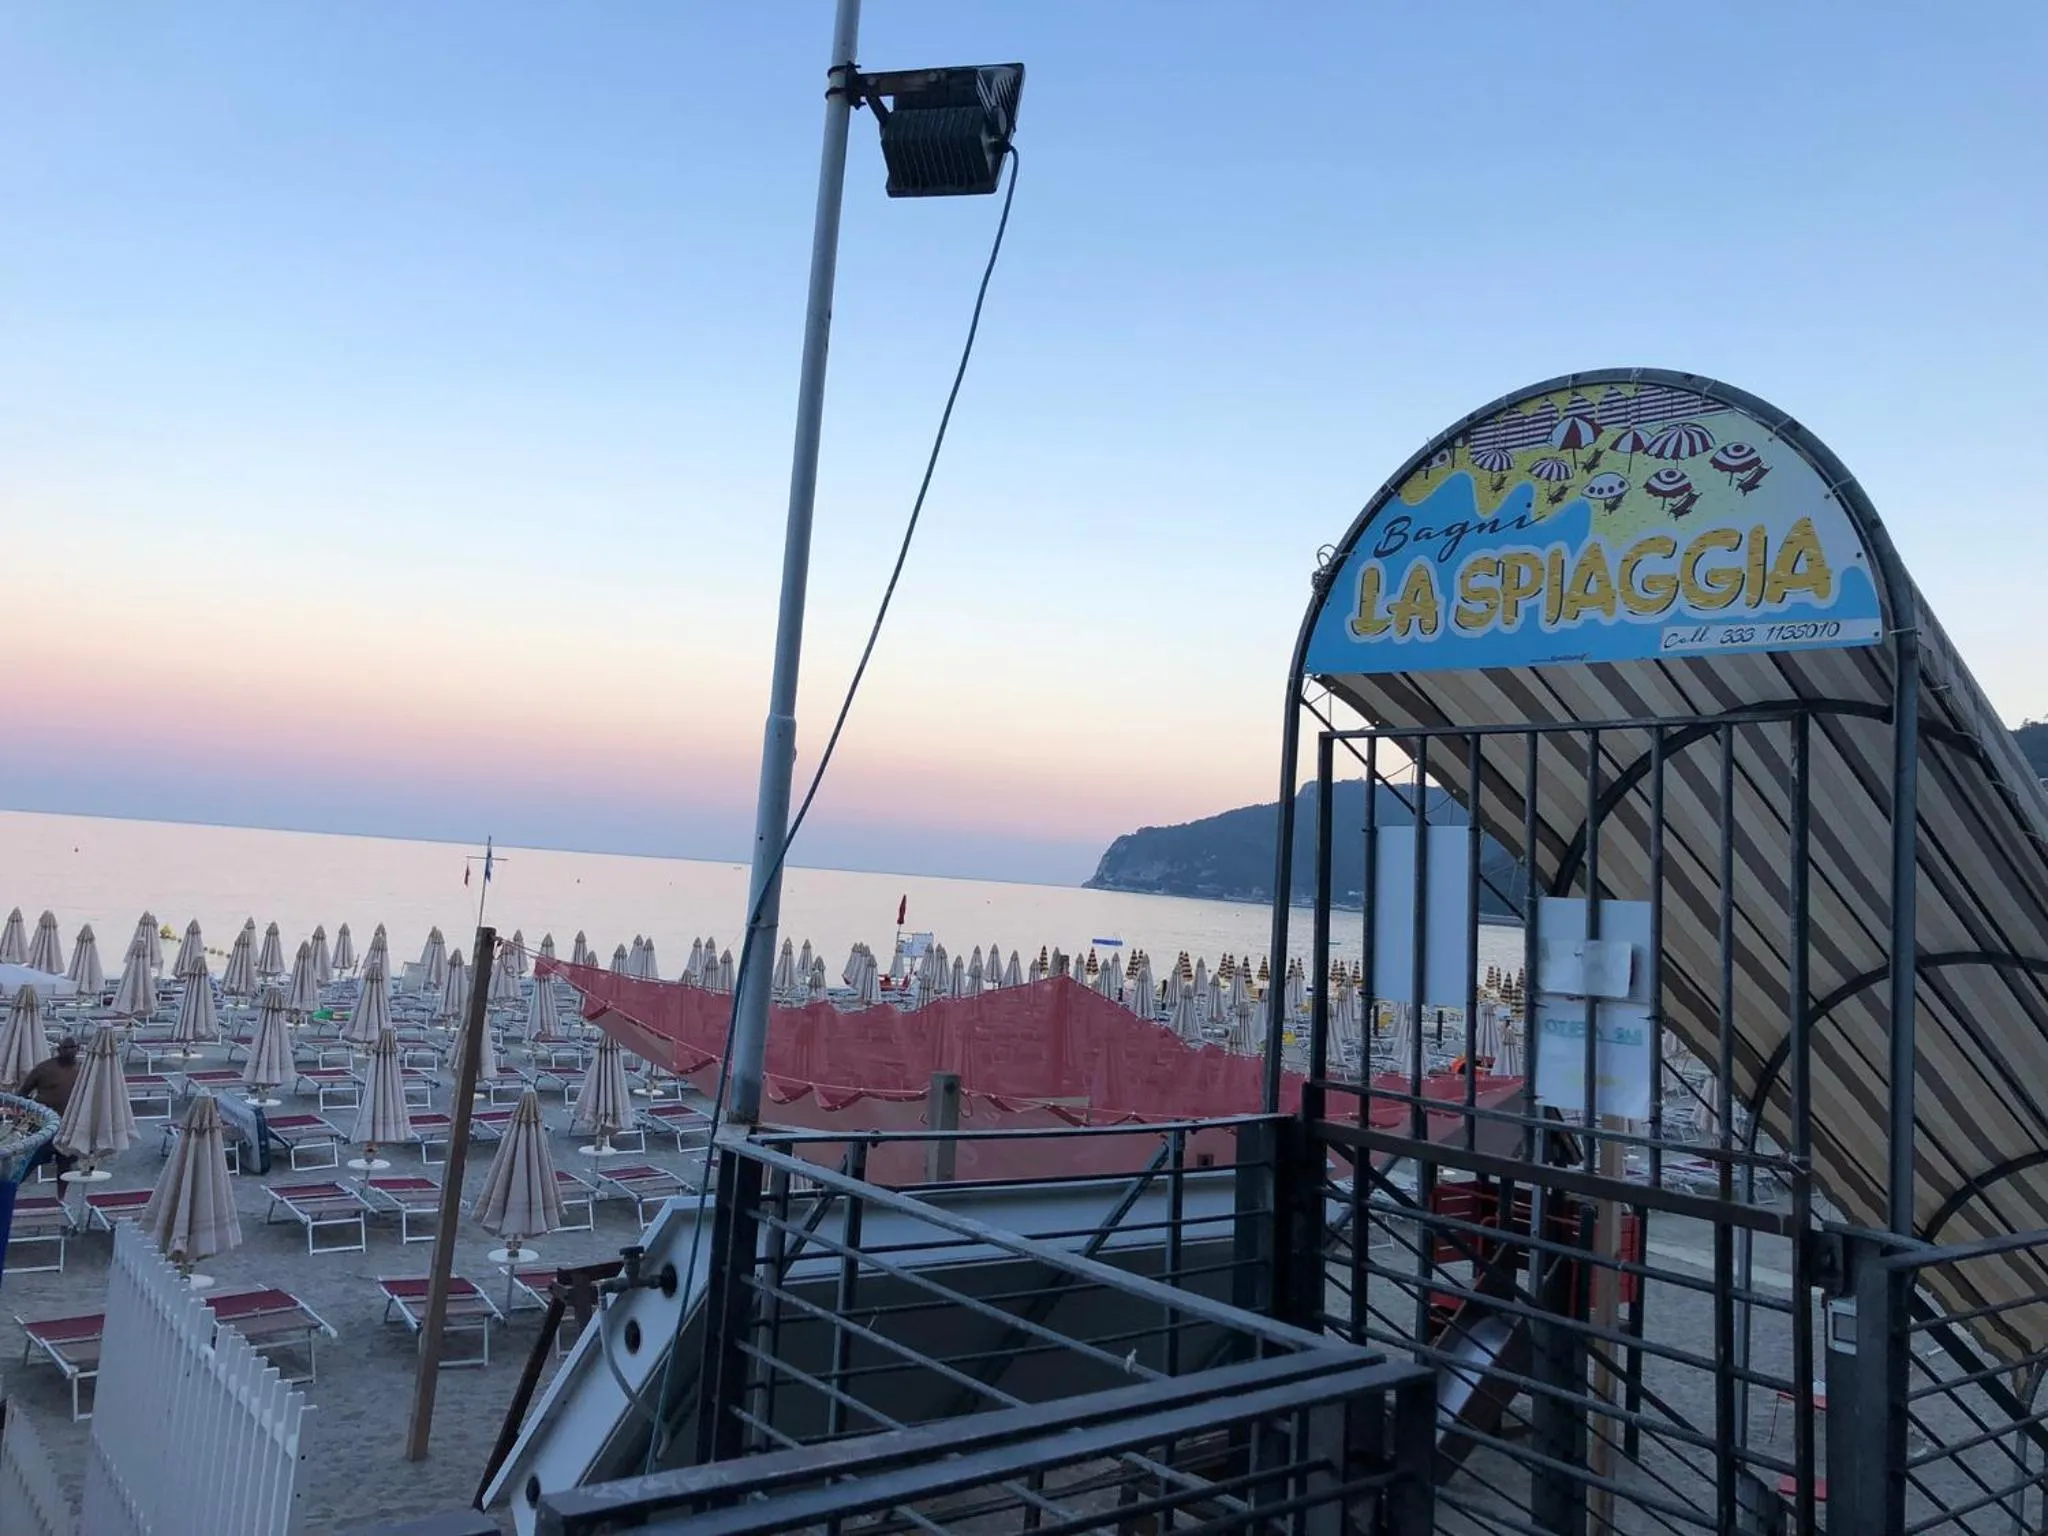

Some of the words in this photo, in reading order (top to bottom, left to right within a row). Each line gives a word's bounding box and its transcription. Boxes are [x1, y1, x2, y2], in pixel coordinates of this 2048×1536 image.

[1373, 501, 1546, 563] Bagni
[1350, 562, 1439, 638] LA
[1453, 515, 1834, 632] SPIAGGIA
[1719, 627, 1755, 645] 333
